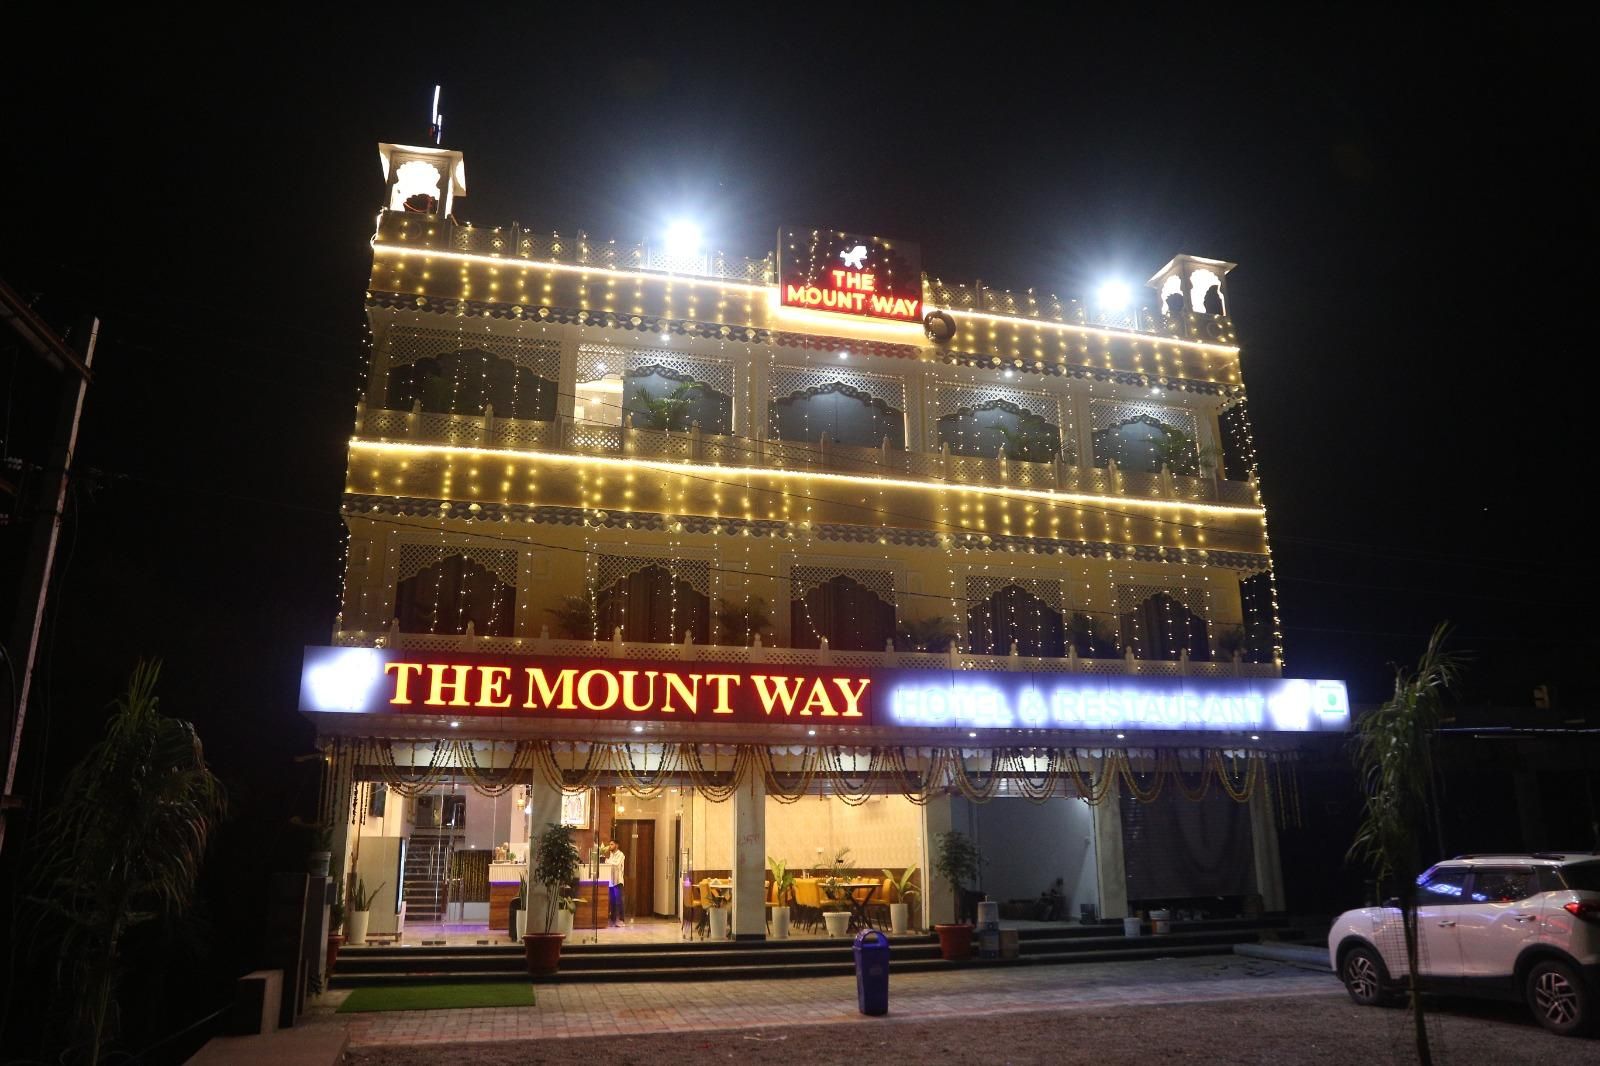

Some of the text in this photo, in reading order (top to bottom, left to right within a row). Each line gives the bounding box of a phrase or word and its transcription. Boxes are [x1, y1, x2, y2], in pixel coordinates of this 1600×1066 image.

[832, 269, 875, 291] THE
[787, 284, 919, 317] MOUNT WAY
[384, 662, 871, 718] THE MOUNT WAY
[895, 687, 1265, 724] HOTEL & RESTAURANT
